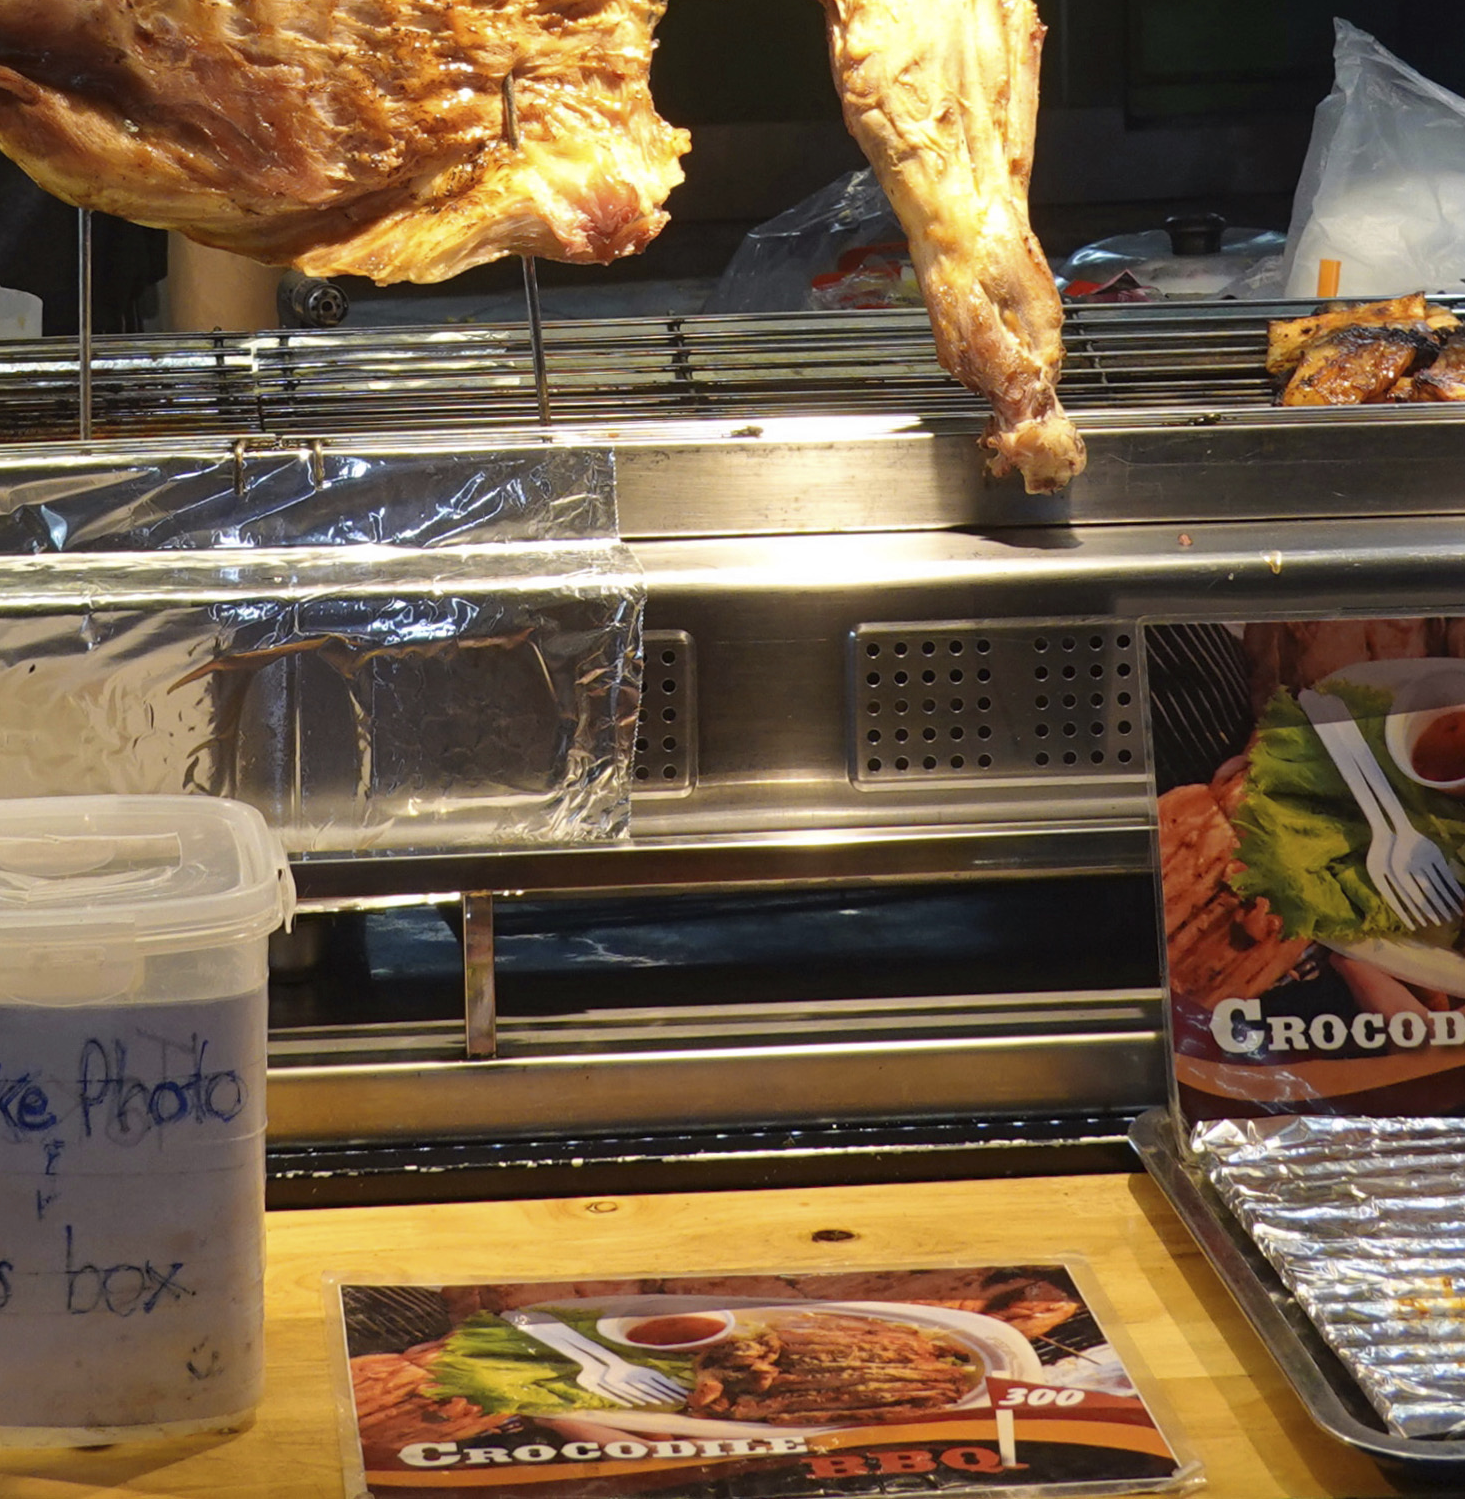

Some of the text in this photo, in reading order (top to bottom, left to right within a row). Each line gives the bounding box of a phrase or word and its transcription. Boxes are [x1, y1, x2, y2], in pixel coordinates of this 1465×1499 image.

[78, 1034, 248, 1140] Photo
[997, 1387, 1086, 1408] 300
[799, 1445, 1029, 1481] BBQ
